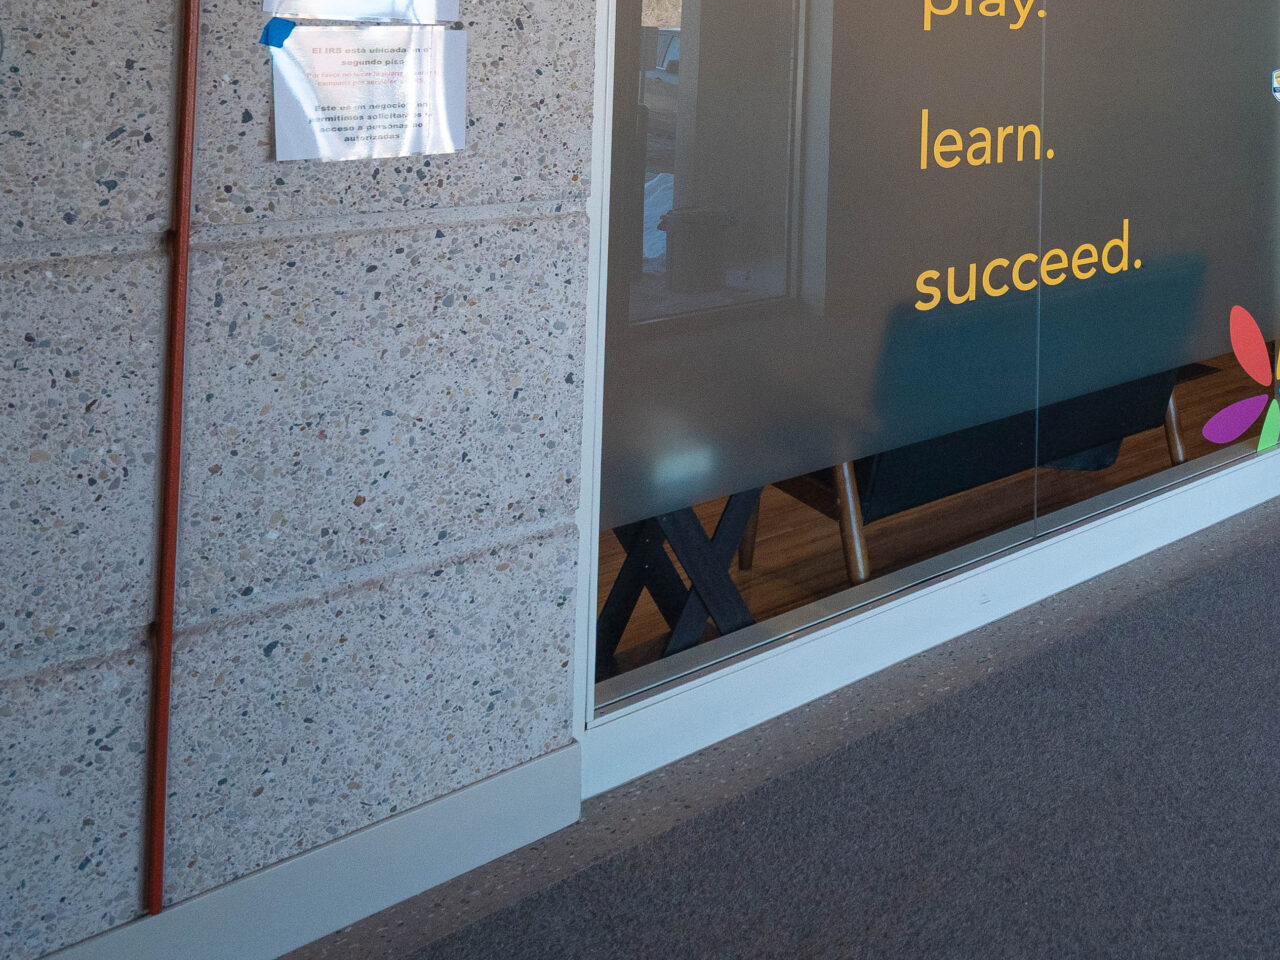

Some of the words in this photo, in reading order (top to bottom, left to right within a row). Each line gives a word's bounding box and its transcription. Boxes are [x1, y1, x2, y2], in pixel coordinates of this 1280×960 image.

[341, 58, 383, 67] segundo
[921, 108, 1055, 170] learn.
[914, 218, 1142, 311] succeed.
